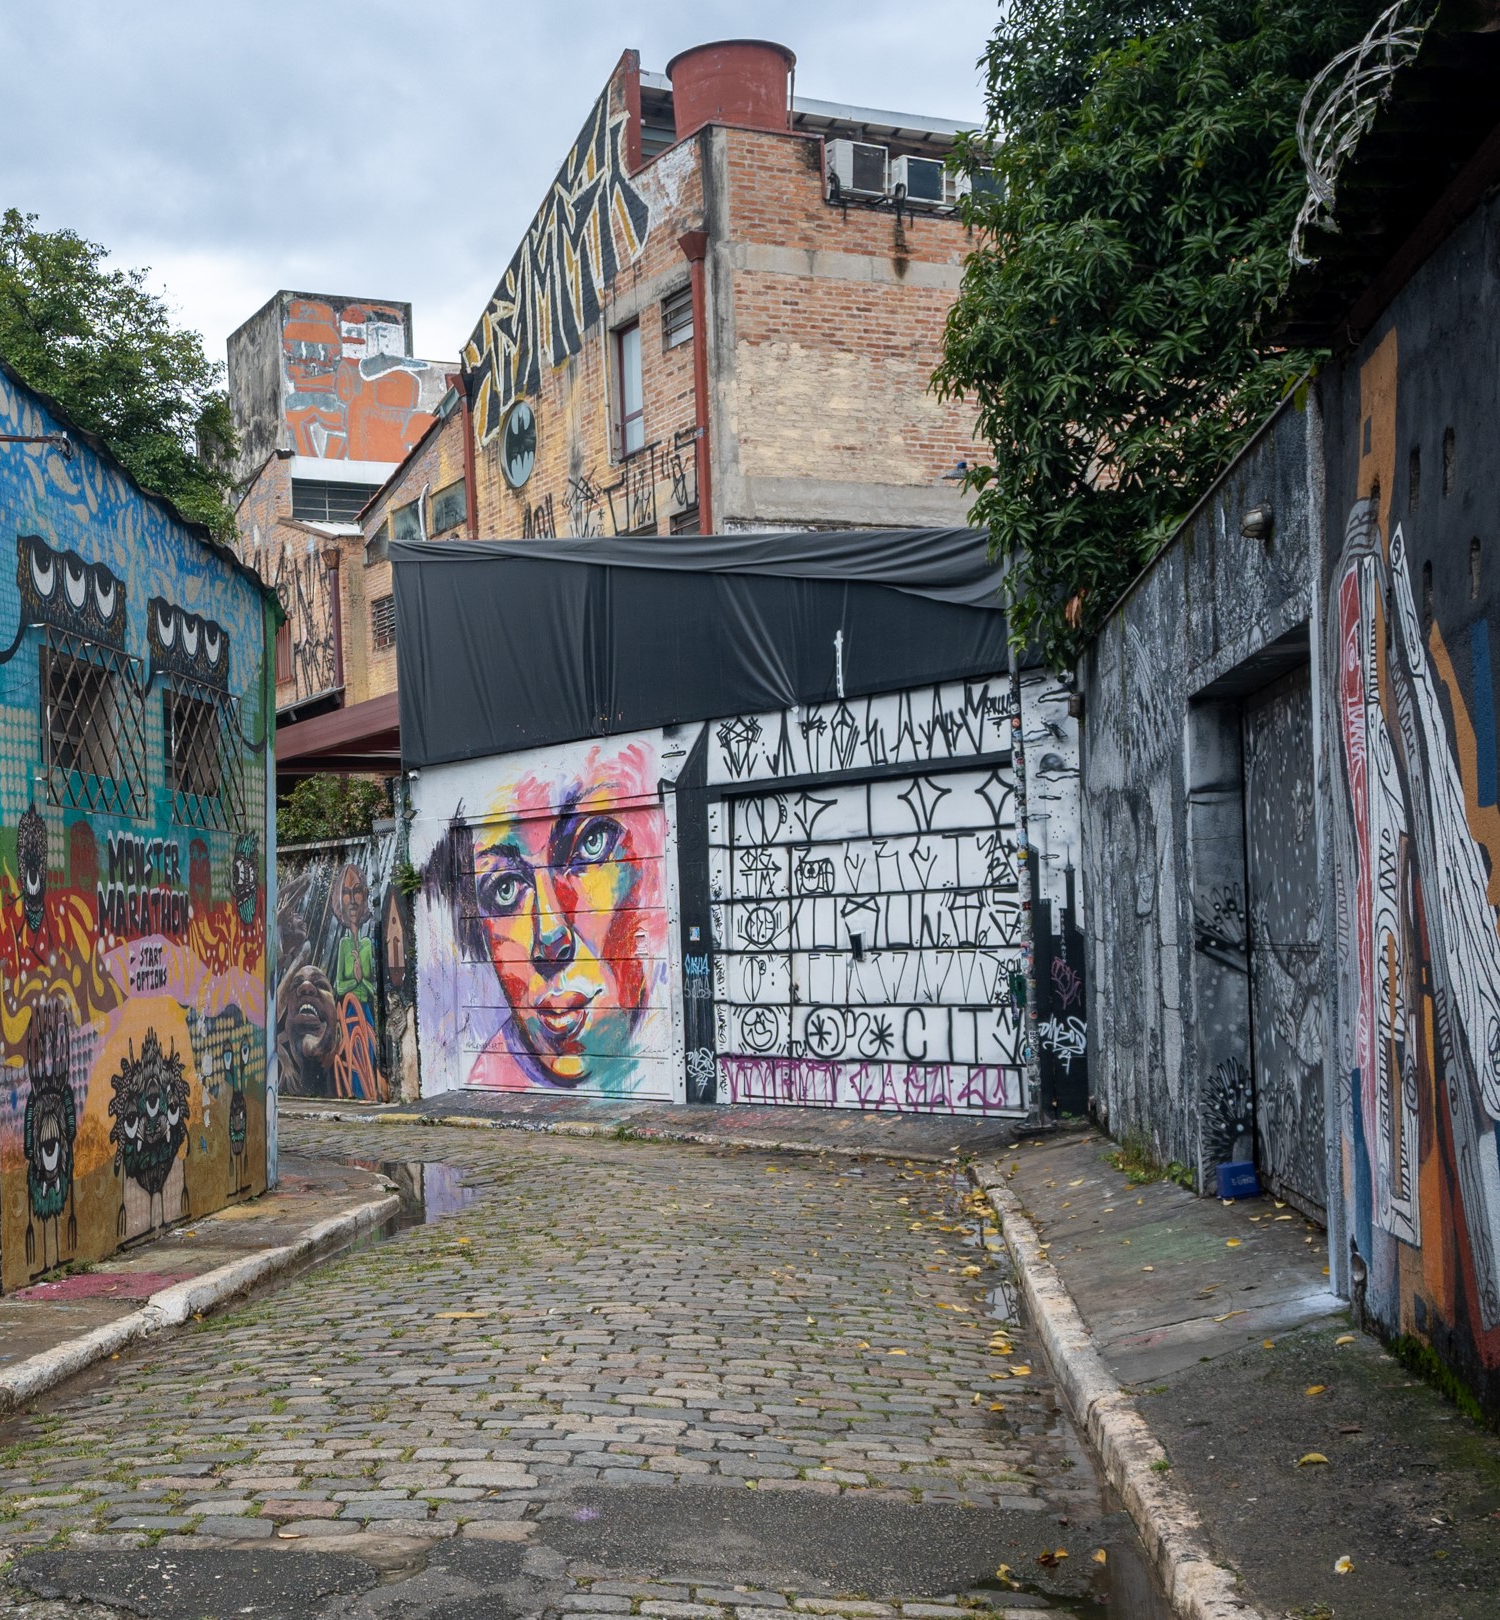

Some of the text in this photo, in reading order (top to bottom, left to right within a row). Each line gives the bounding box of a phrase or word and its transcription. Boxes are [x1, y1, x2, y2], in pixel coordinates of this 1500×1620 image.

[107, 830, 181, 884] MONSTER
[97, 881, 189, 936] MARATHON
[140, 942, 163, 967] START
[137, 968, 167, 991] OPTIONS
